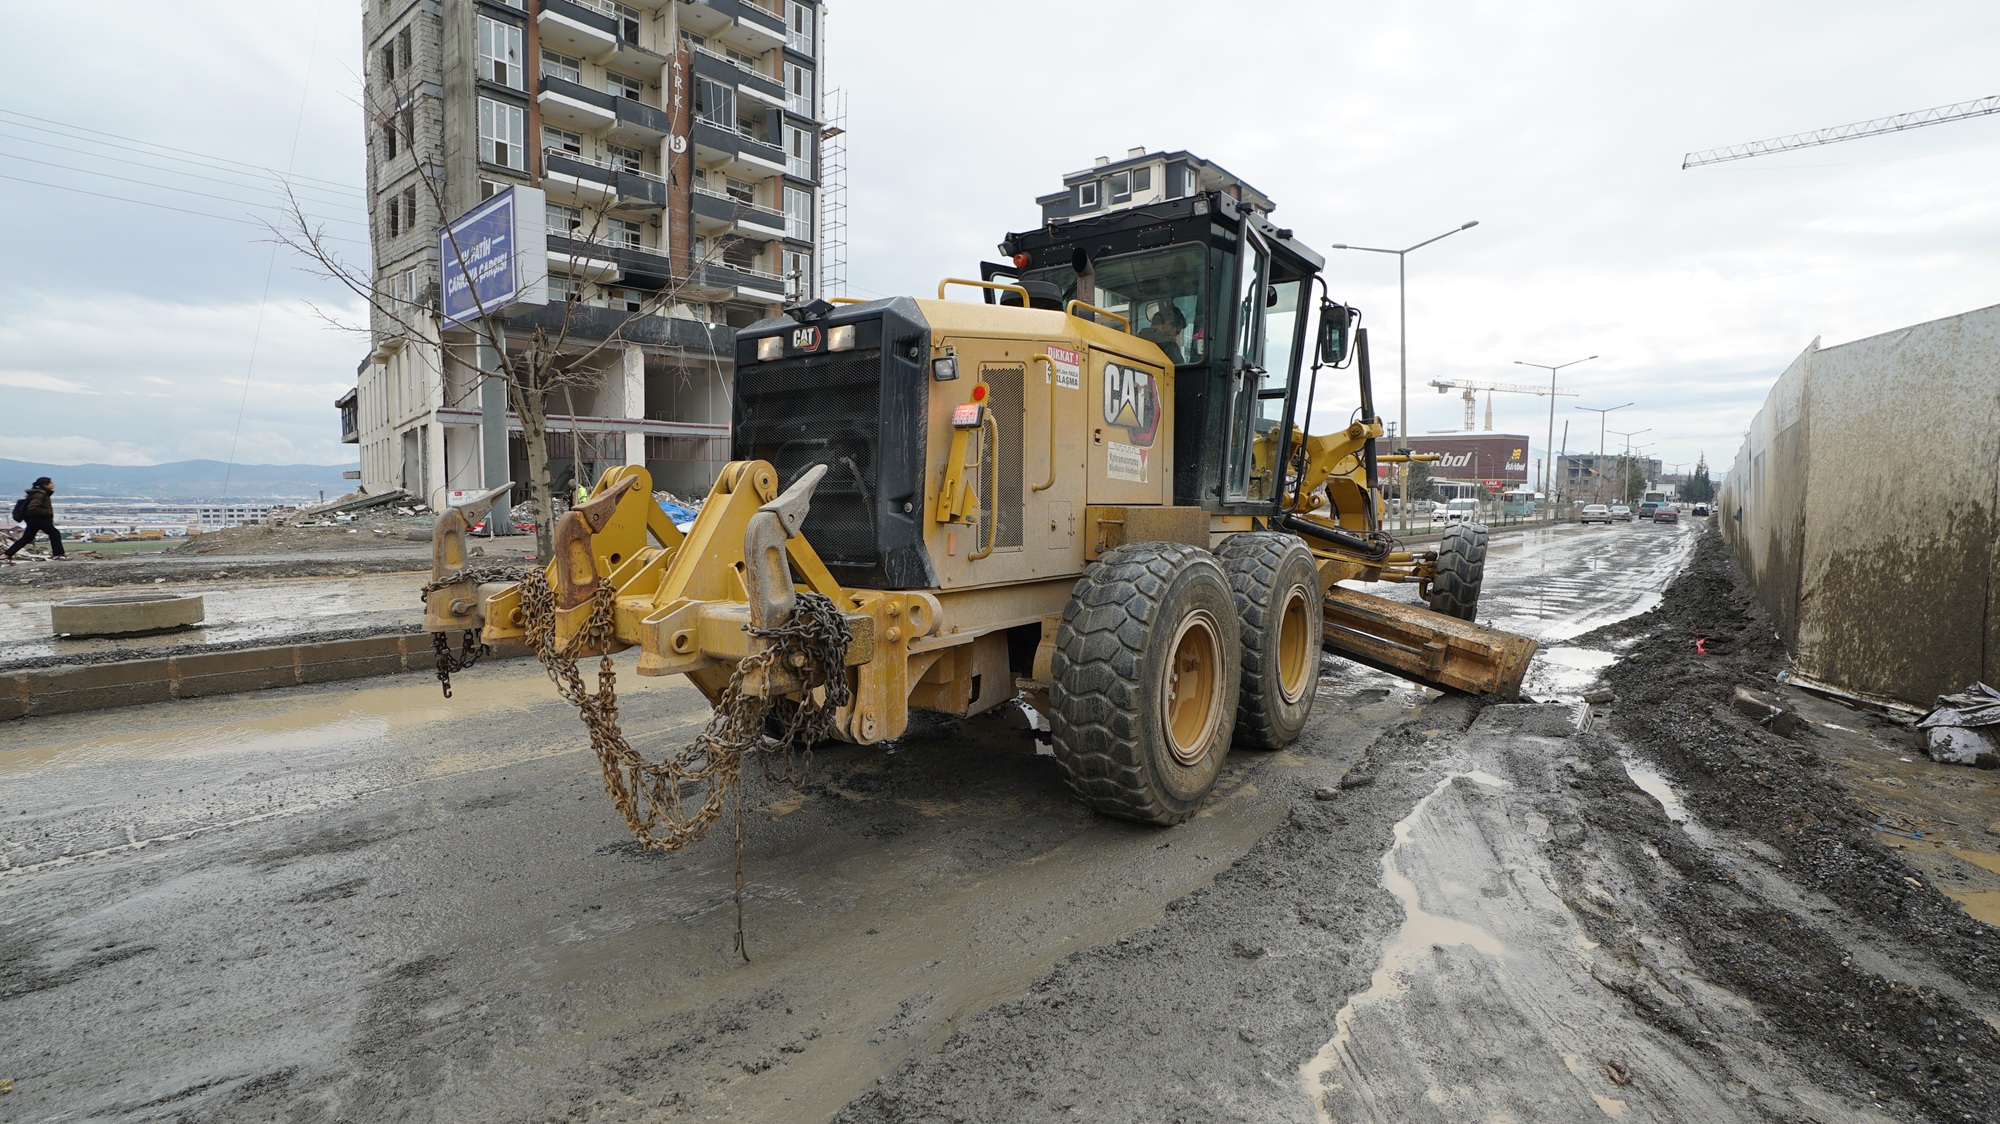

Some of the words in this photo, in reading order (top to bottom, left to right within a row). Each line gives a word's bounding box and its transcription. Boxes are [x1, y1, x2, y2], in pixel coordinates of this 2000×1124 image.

[471, 236, 491, 263] FATİH
[793, 328, 815, 348] CAT
[1047, 372, 1079, 387] YKLAŞMA
[1104, 363, 1149, 429] CAT
